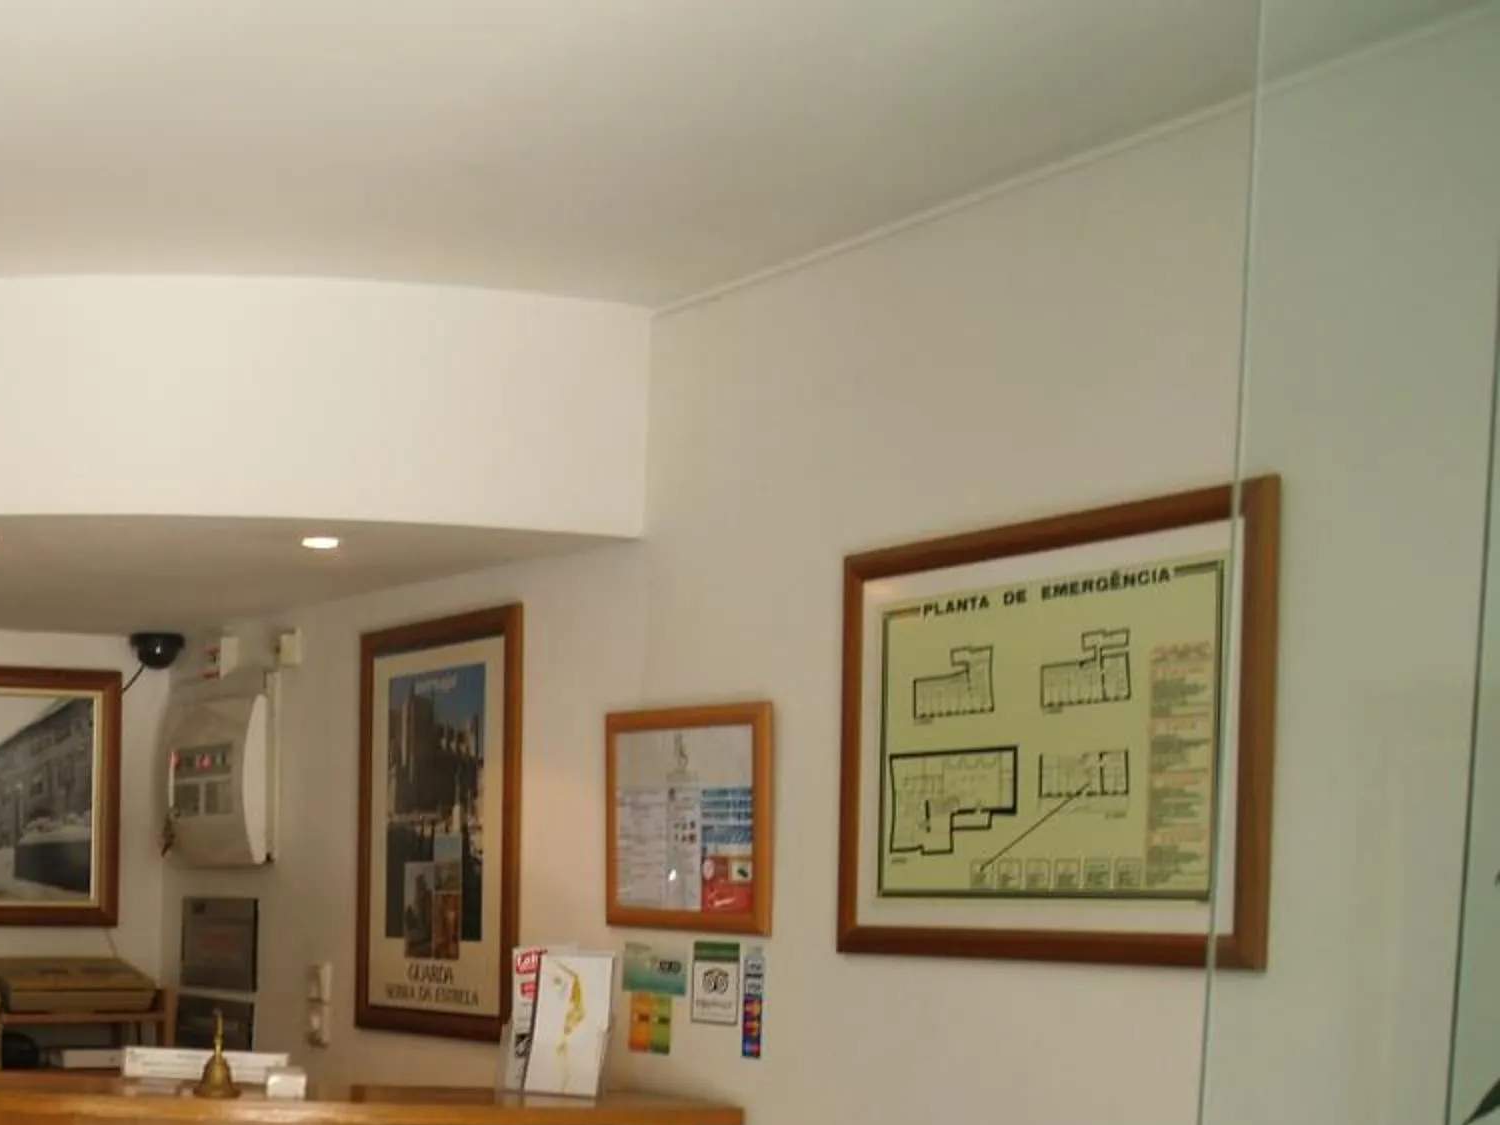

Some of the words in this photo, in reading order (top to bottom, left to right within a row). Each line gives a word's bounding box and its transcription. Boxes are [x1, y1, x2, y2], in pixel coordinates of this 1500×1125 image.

[923, 595, 990, 617] PLANTA
[1003, 589, 1027, 606] DE
[1041, 566, 1170, 601] EMERGÊNCIA
[407, 963, 454, 985] GUARDA
[435, 987, 479, 1006] ESTRELA
